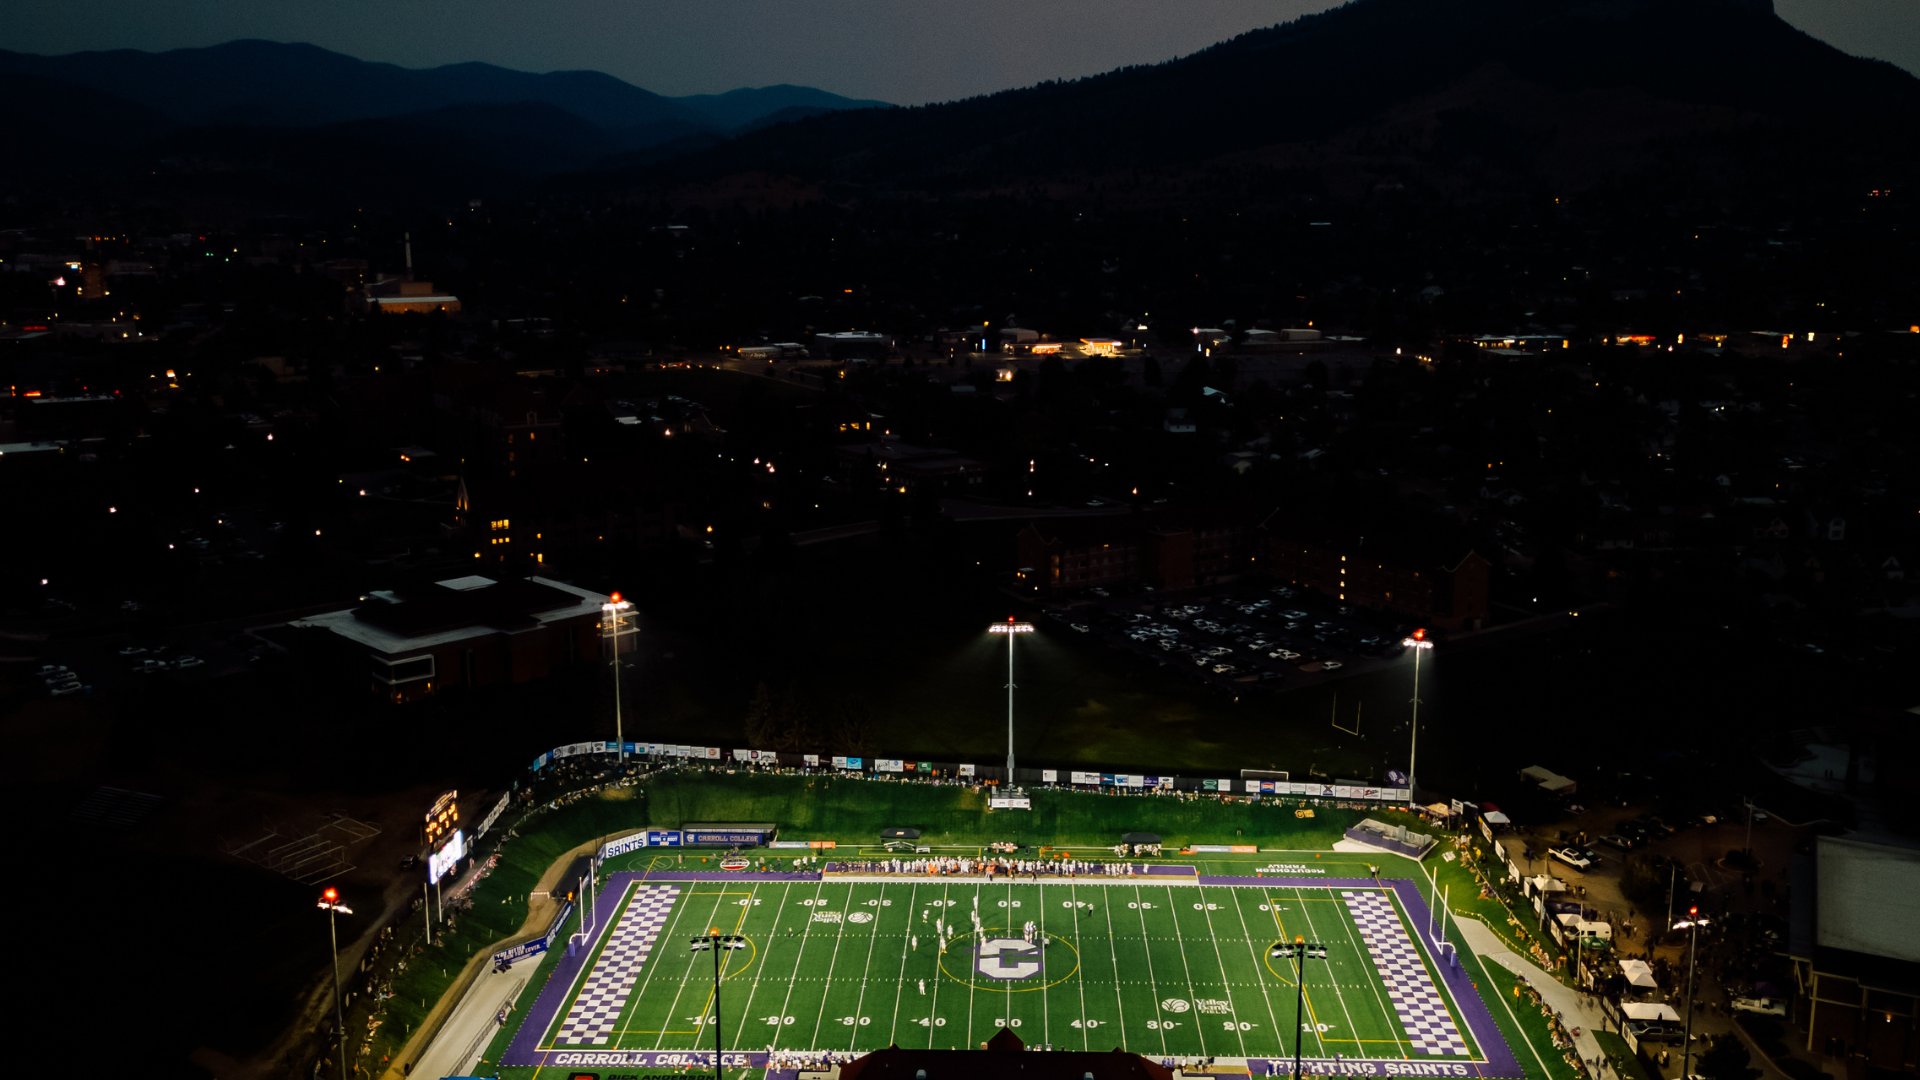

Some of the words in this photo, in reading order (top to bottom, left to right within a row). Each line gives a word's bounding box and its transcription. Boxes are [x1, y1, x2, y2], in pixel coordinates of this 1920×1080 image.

[608, 838, 644, 857] SAINTS
[692, 1016, 717, 1025] 10
[766, 1016, 795, 1025] 20
[843, 1016, 870, 1026] 30
[919, 1017, 946, 1026] 40
[994, 1018, 1022, 1028] 50
[1070, 1019, 1098, 1028] 40
[1147, 1020, 1174, 1030] 30
[1223, 1022, 1251, 1031] 20
[1302, 1022, 1328, 1032] 10
[555, 1053, 648, 1065] CARROLL
[1384, 1063, 1468, 1076] SAINTS
